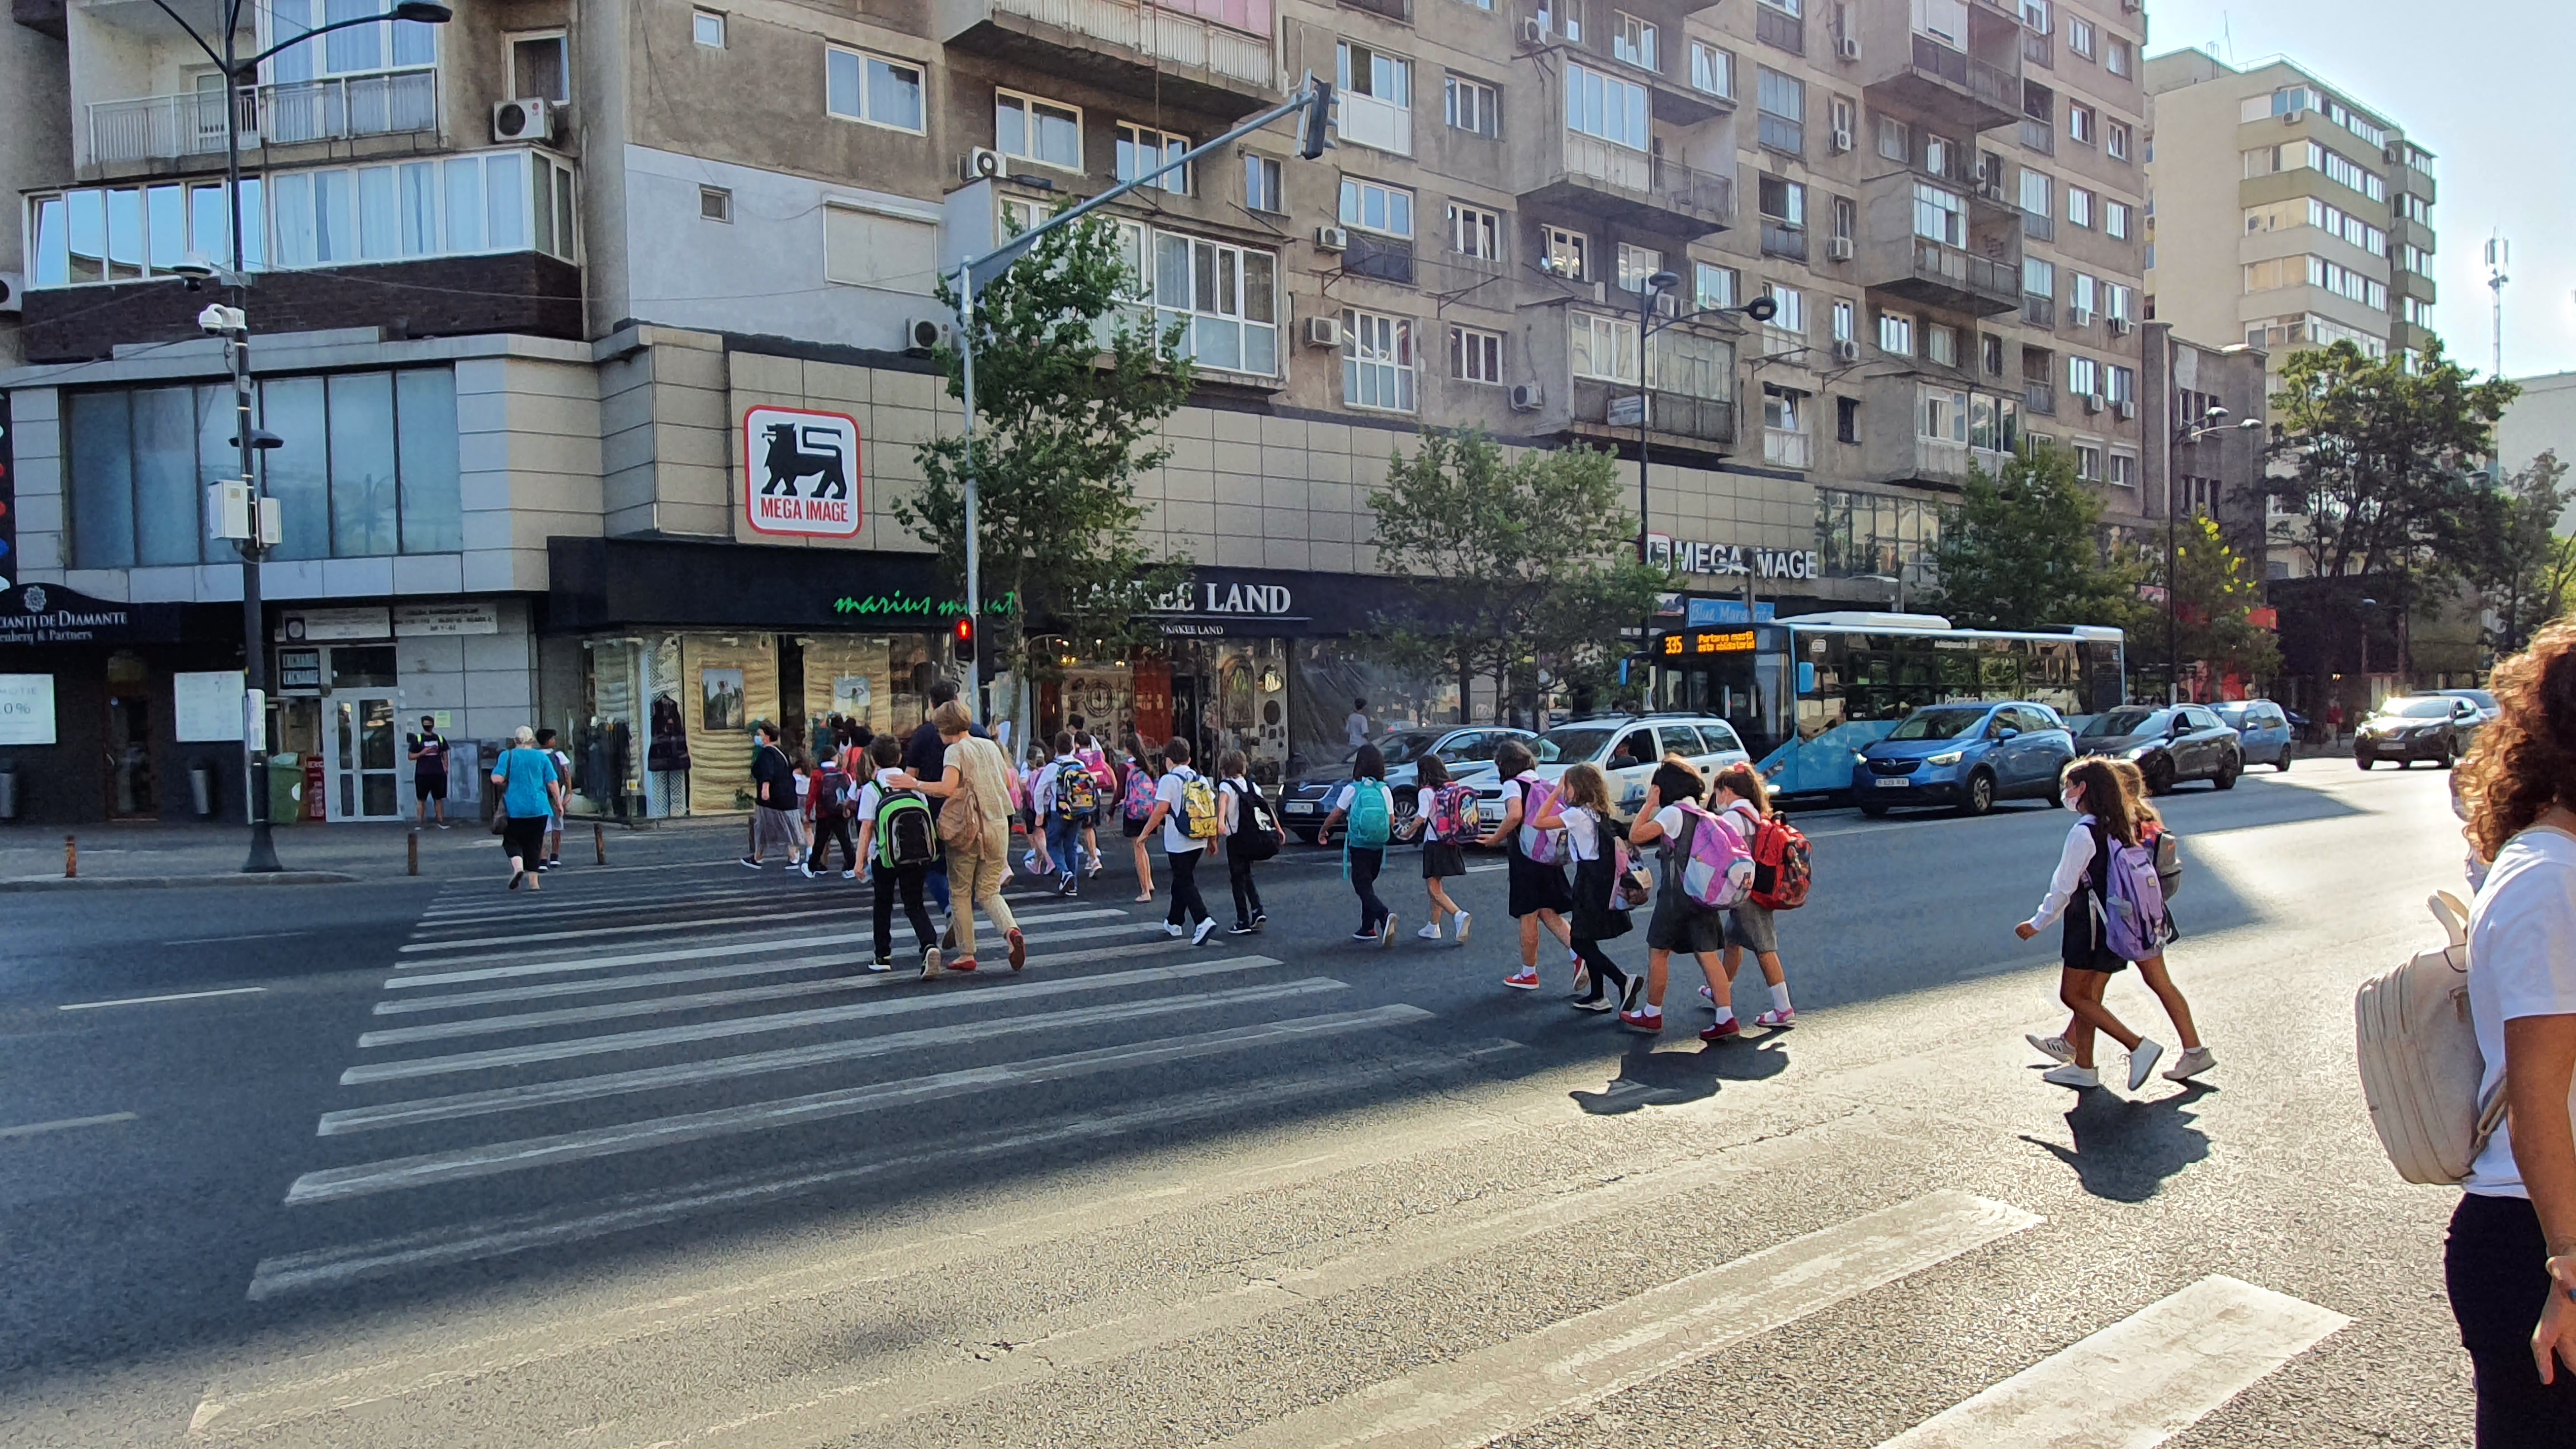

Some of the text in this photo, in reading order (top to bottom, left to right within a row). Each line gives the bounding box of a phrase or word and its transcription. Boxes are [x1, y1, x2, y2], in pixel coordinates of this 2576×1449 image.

[761, 497, 849, 523] MEGA IMAGE
[1675, 541, 1817, 579] MEGA MAGE
[833, 590, 931, 615] marius
[1204, 583, 1291, 613] LAND
[40, 614, 56, 628] DE
[1159, 624, 1224, 635] YANKEE LAND
[1665, 636, 1683, 654] 335
[0, 703, 31, 714] 0%
